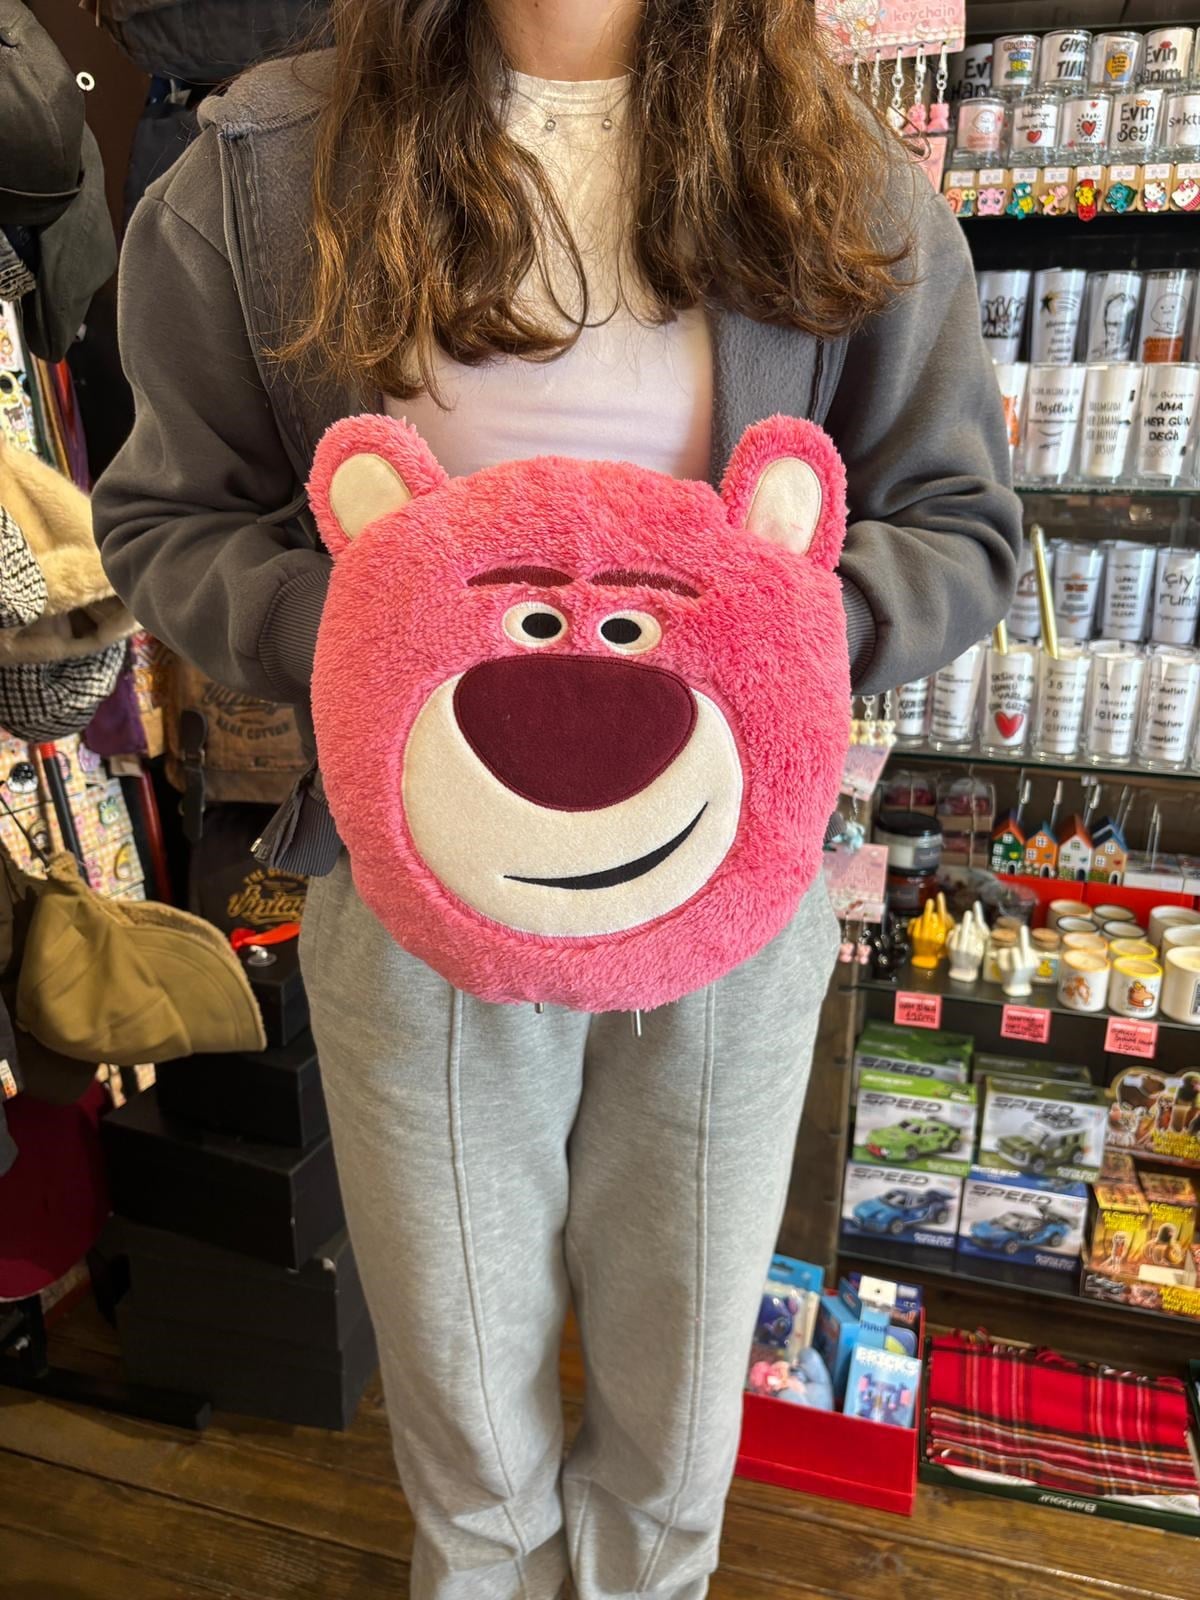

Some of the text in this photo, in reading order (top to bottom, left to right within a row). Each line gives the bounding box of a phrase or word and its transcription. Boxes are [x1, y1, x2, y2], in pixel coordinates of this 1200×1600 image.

[894, 6, 956, 22] keychain
[1121, 103, 1155, 121] Evin
[858, 1056, 935, 1078] SPEED
[861, 1093, 943, 1113] SPEED
[990, 1096, 1074, 1115] SPEED
[850, 1167, 930, 1185] SPEED
[968, 1184, 1052, 1205] SPEED
[1038, 1494, 1097, 1513] Barbour
